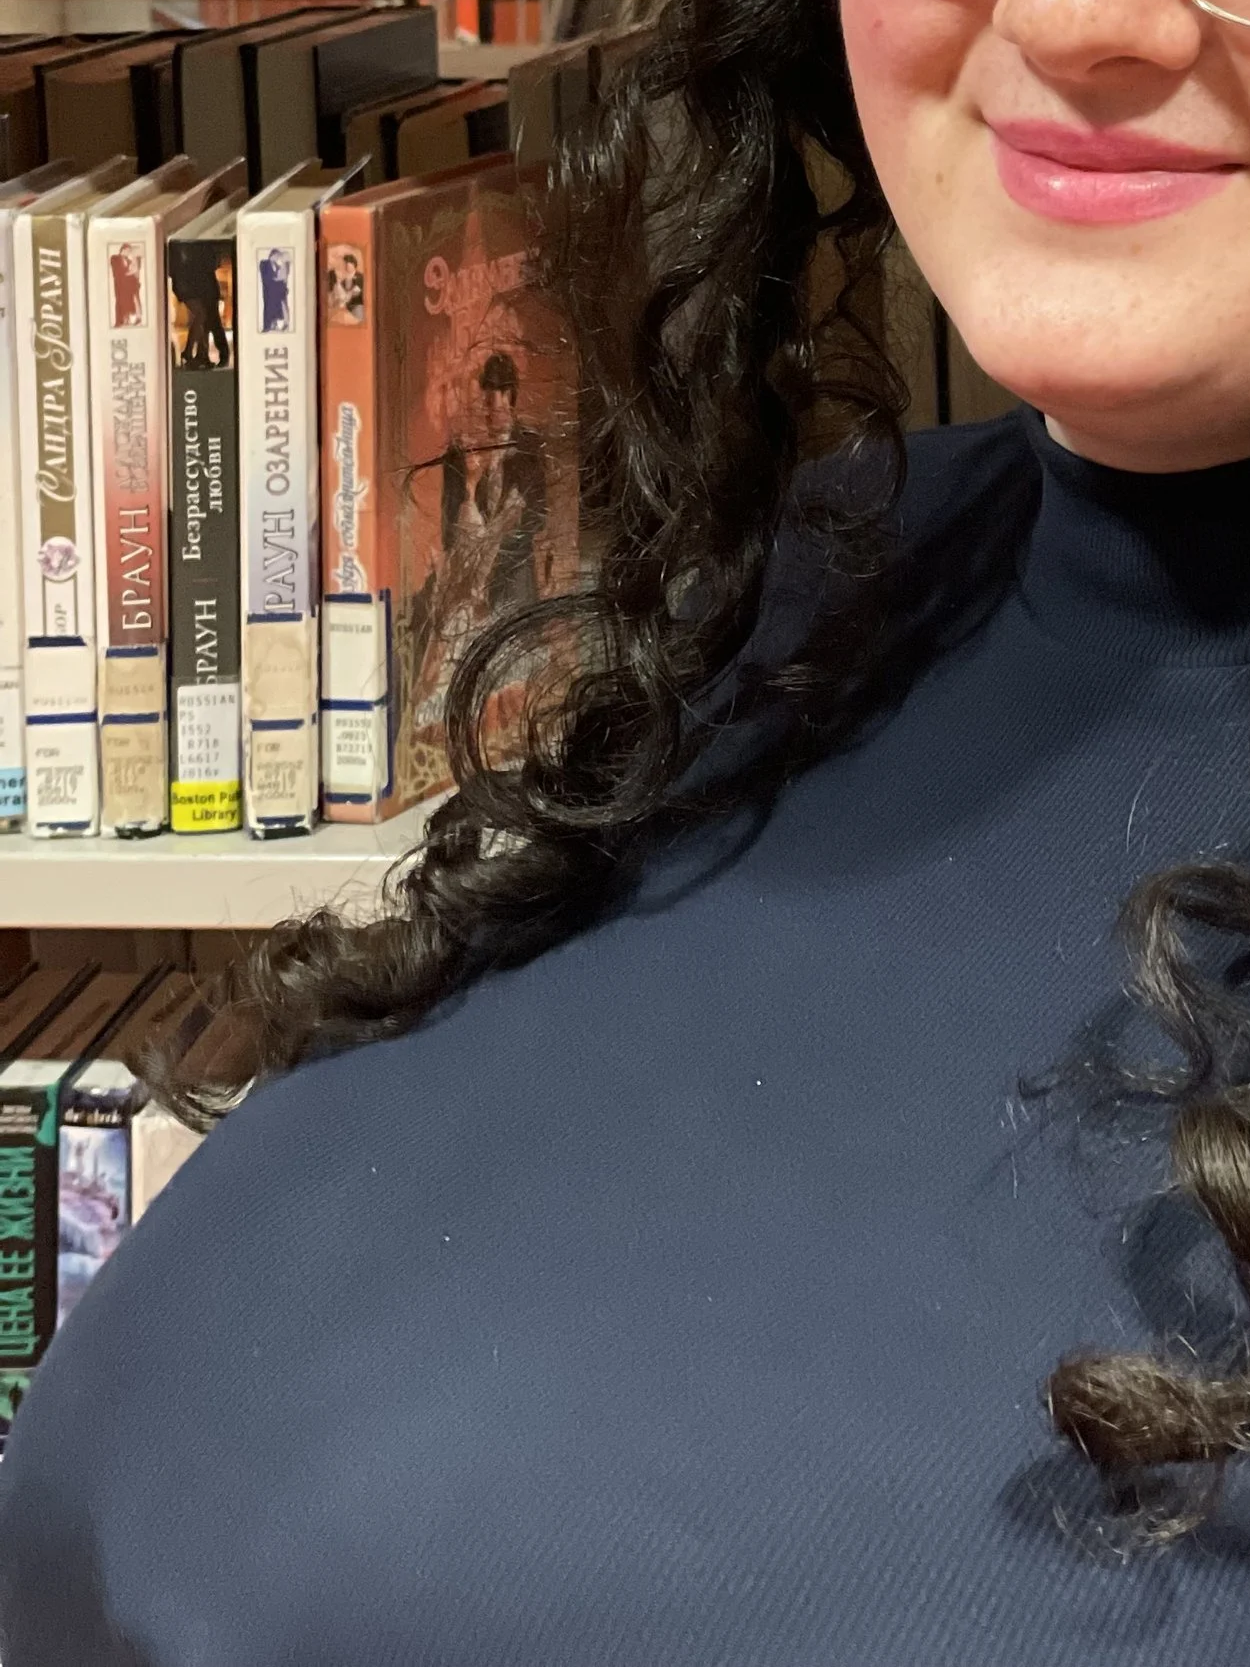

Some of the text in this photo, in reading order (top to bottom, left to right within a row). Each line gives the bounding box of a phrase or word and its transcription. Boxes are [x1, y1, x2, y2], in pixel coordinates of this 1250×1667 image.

[28, 242, 77, 508] САНДРА БРАУН
[180, 389, 206, 562] Безрассудство
[205, 436, 225, 514] любви
[261, 346, 297, 614] РАУН ОЗАРЕНИЕ
[119, 503, 153, 630] БРАУН
[179, 695, 237, 708] RUSSIAN
[172, 792, 216, 805] Boston
[191, 807, 238, 822] Library
[0, 1145, 35, 1239] ЖИЗНИ
[0, 1248, 35, 1281] ЕЕ
